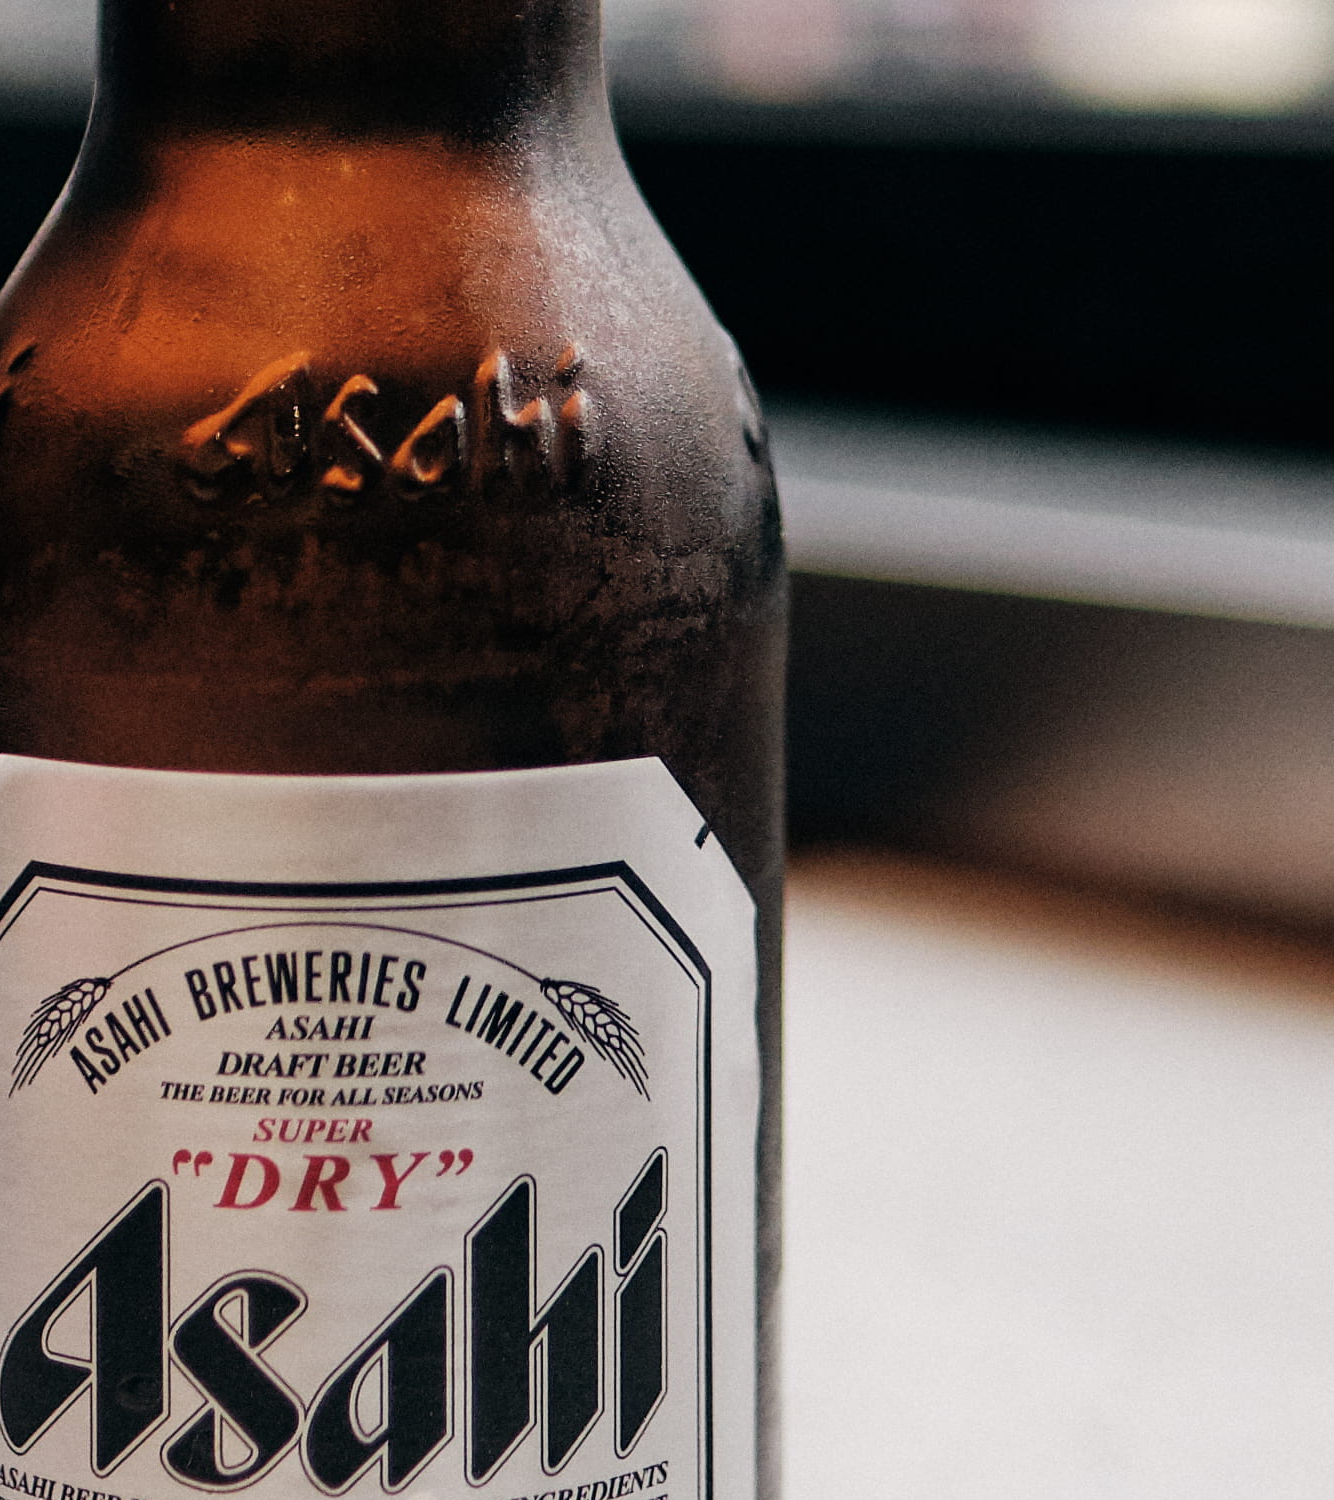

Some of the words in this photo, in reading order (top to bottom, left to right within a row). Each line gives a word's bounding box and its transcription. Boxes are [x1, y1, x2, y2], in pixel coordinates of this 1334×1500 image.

[69, 987, 173, 1095] ASAHI
[184, 950, 427, 1021] BREWERIES
[445, 975, 586, 1096] LIMITED
[266, 1016, 374, 1041] ASAHI
[217, 1051, 328, 1078] DRAFT
[334, 1051, 427, 1077] BEER
[160, 1081, 205, 1101] THE
[209, 1085, 272, 1105] BEER
[278, 1088, 326, 1106] FOR
[326, 1088, 377, 1107] ALL
[382, 1081, 485, 1105] SEASONS
[253, 1118, 373, 1143] SUPER
